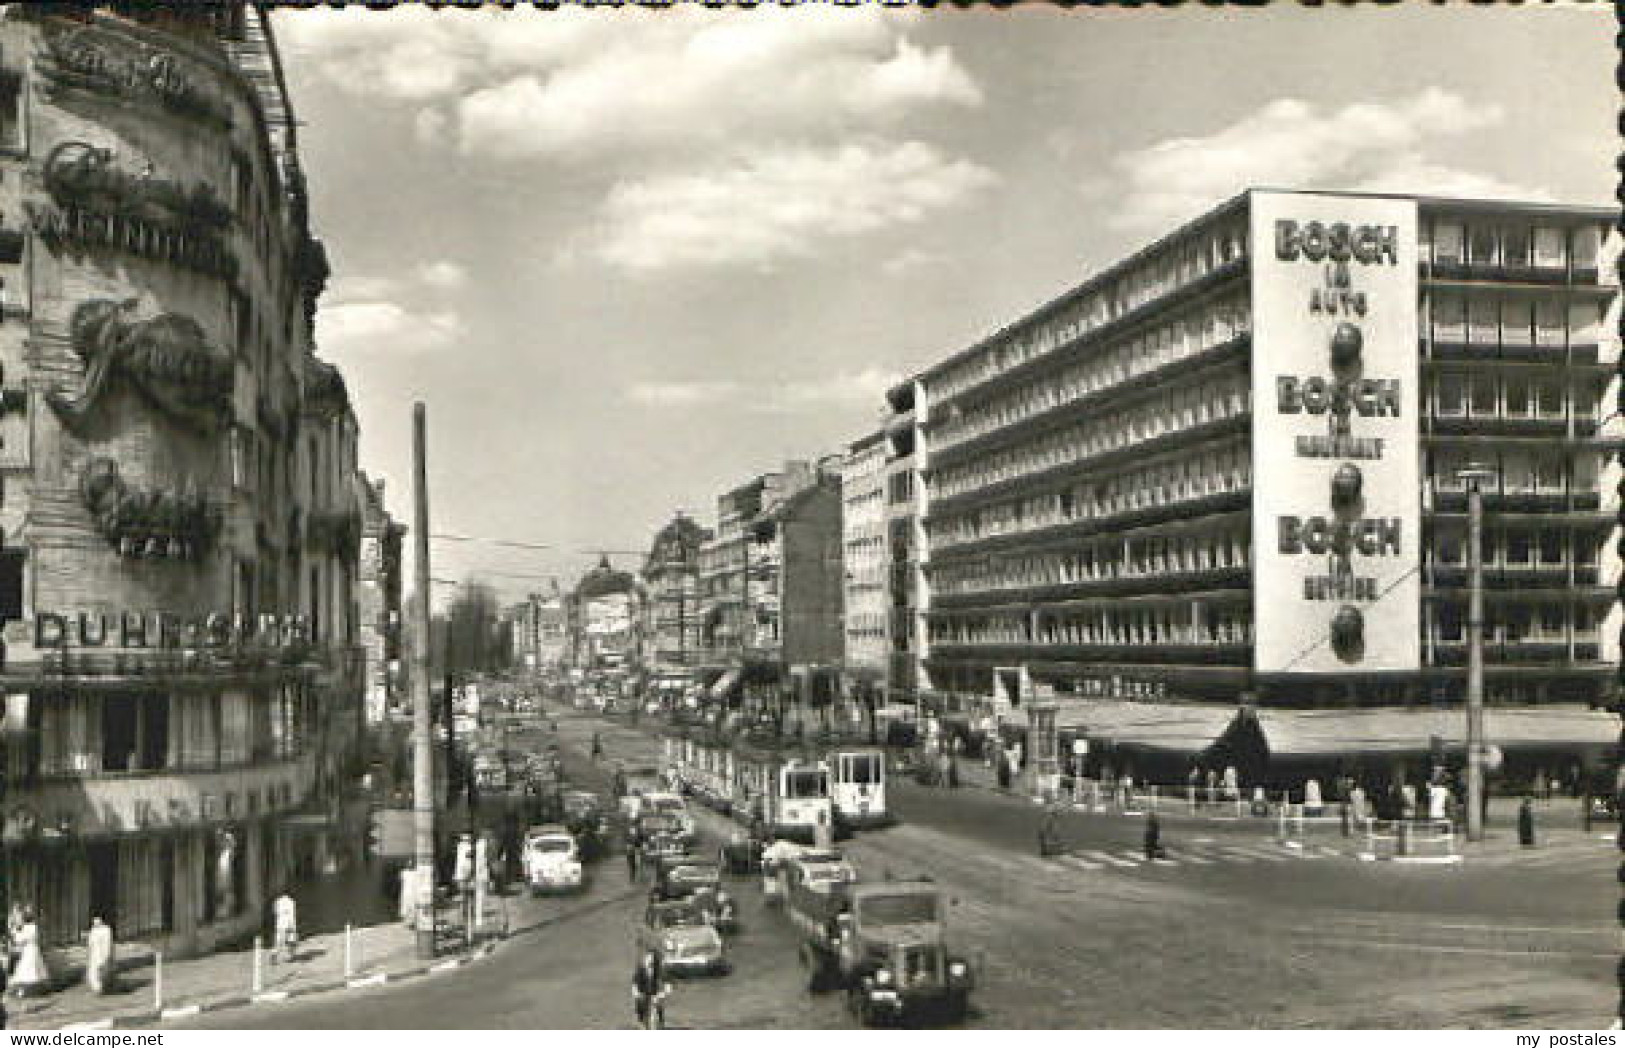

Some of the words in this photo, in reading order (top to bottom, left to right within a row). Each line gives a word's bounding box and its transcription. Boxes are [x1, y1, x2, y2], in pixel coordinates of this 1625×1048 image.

[1275, 219, 1399, 266] BOSCH
[1310, 288, 1367, 318] AUTO
[1277, 376, 1400, 417] BOSCH
[1277, 516, 1401, 556] BOSCH
